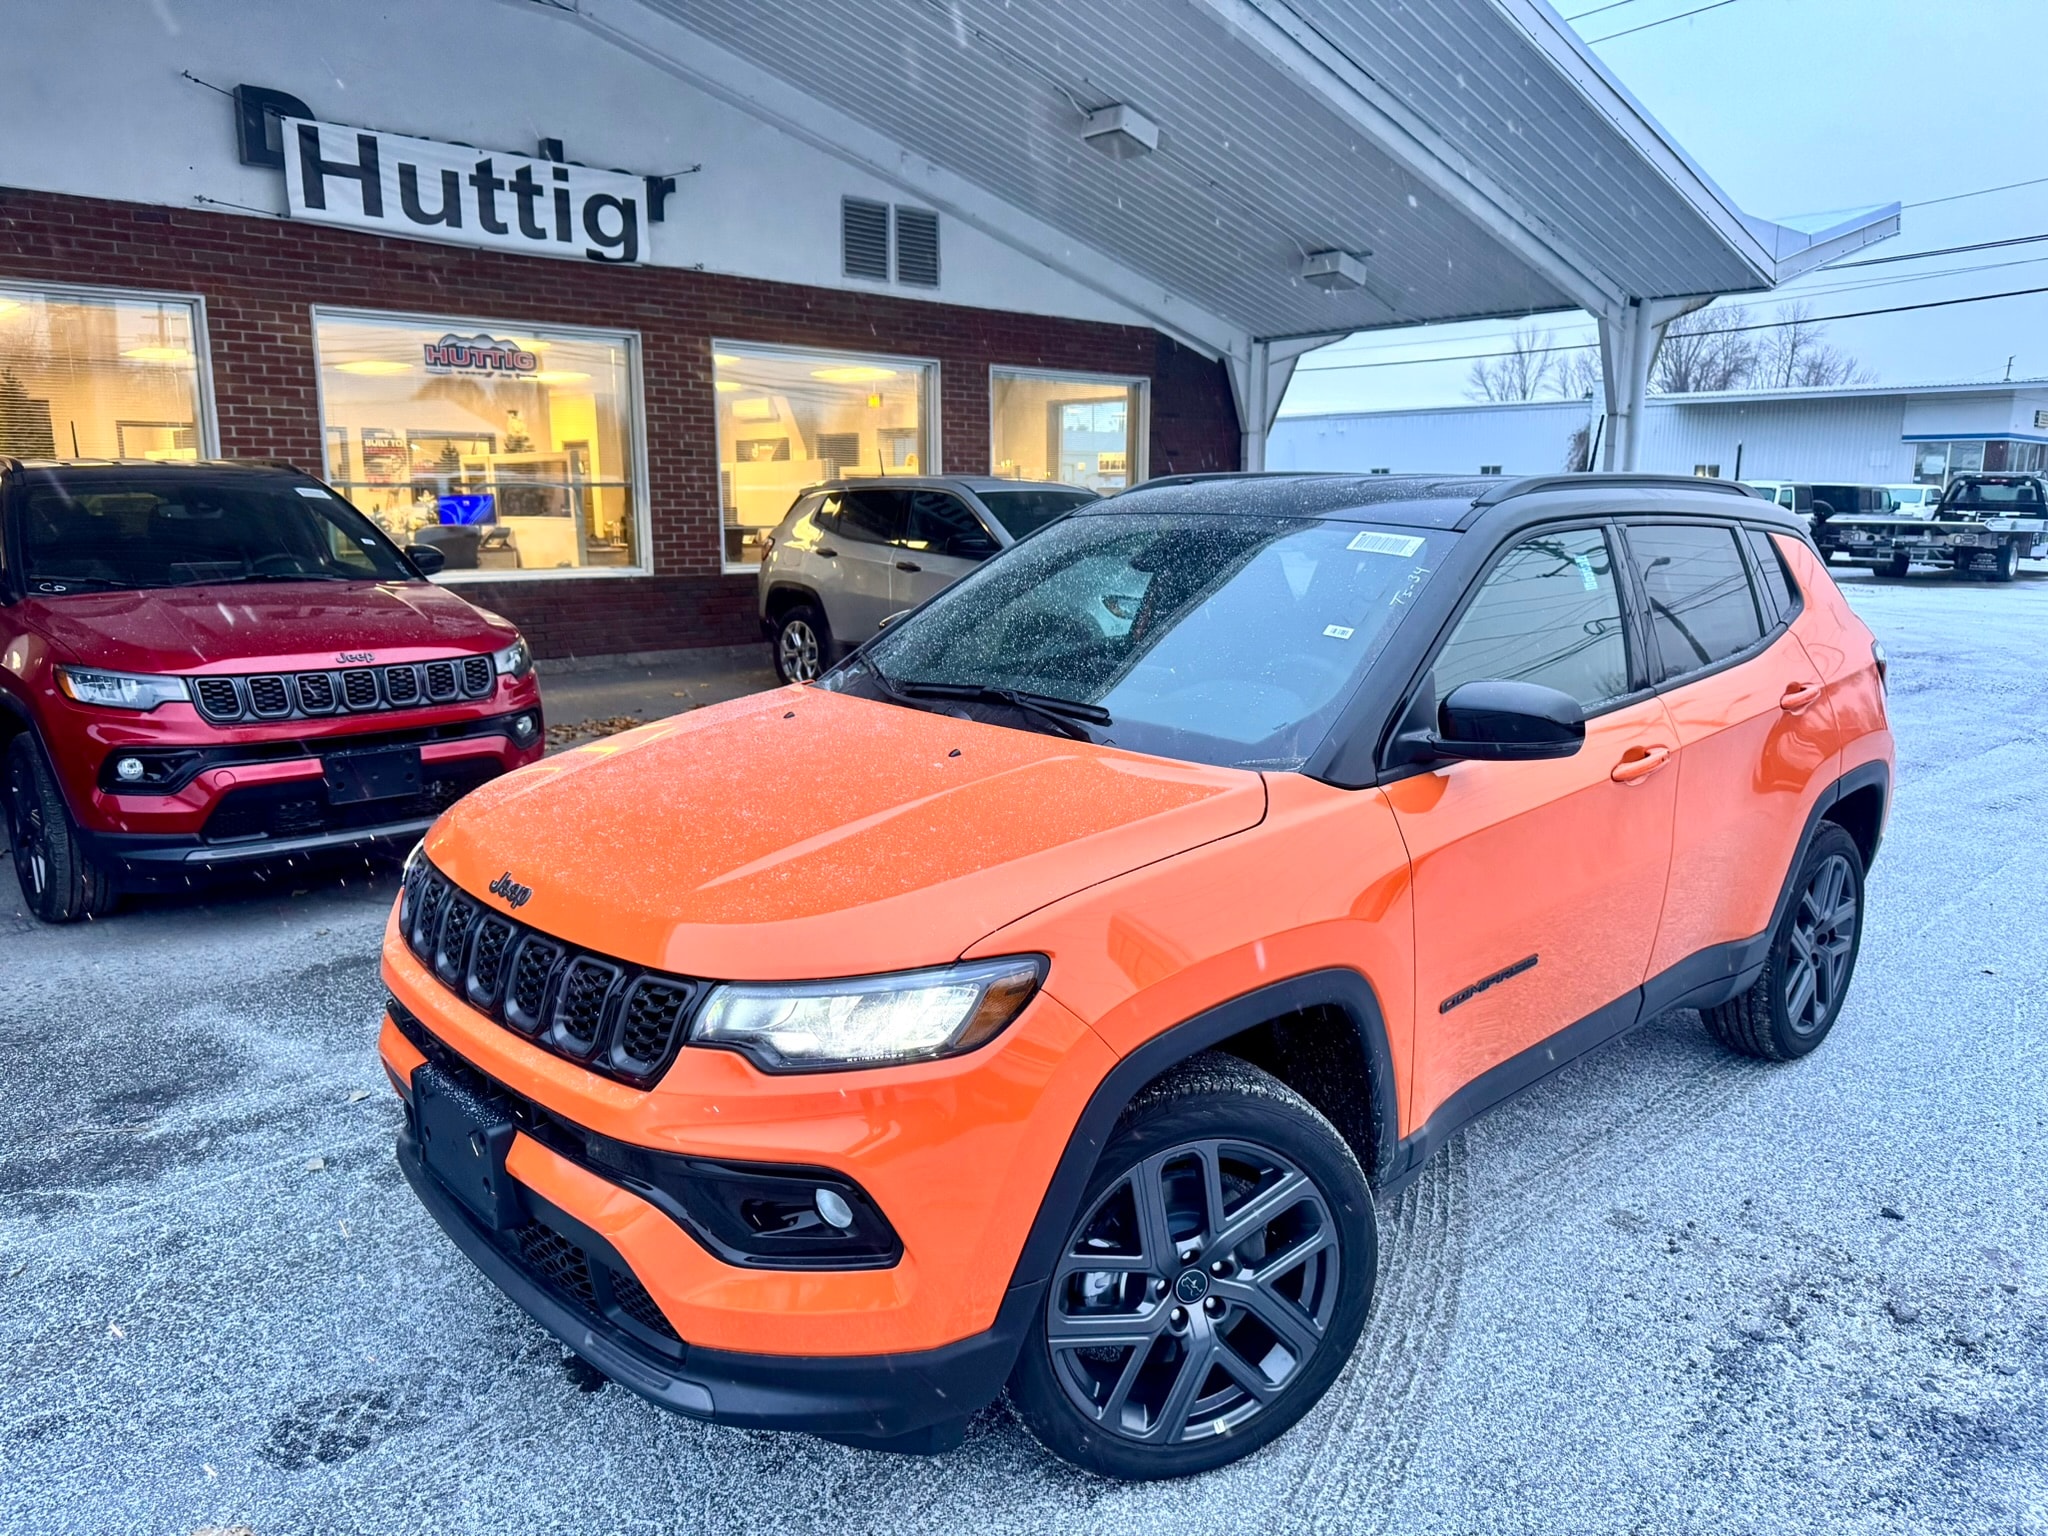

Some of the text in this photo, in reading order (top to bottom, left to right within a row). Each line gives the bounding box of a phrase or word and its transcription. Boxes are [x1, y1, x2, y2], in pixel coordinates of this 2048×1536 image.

[297, 124, 639, 263] Huttig
[424, 343, 537, 371] HUTTIG
[335, 652, 376, 664] Jeep
[489, 871, 532, 910] Jeep
[1439, 953, 1539, 1014] COMPASS
